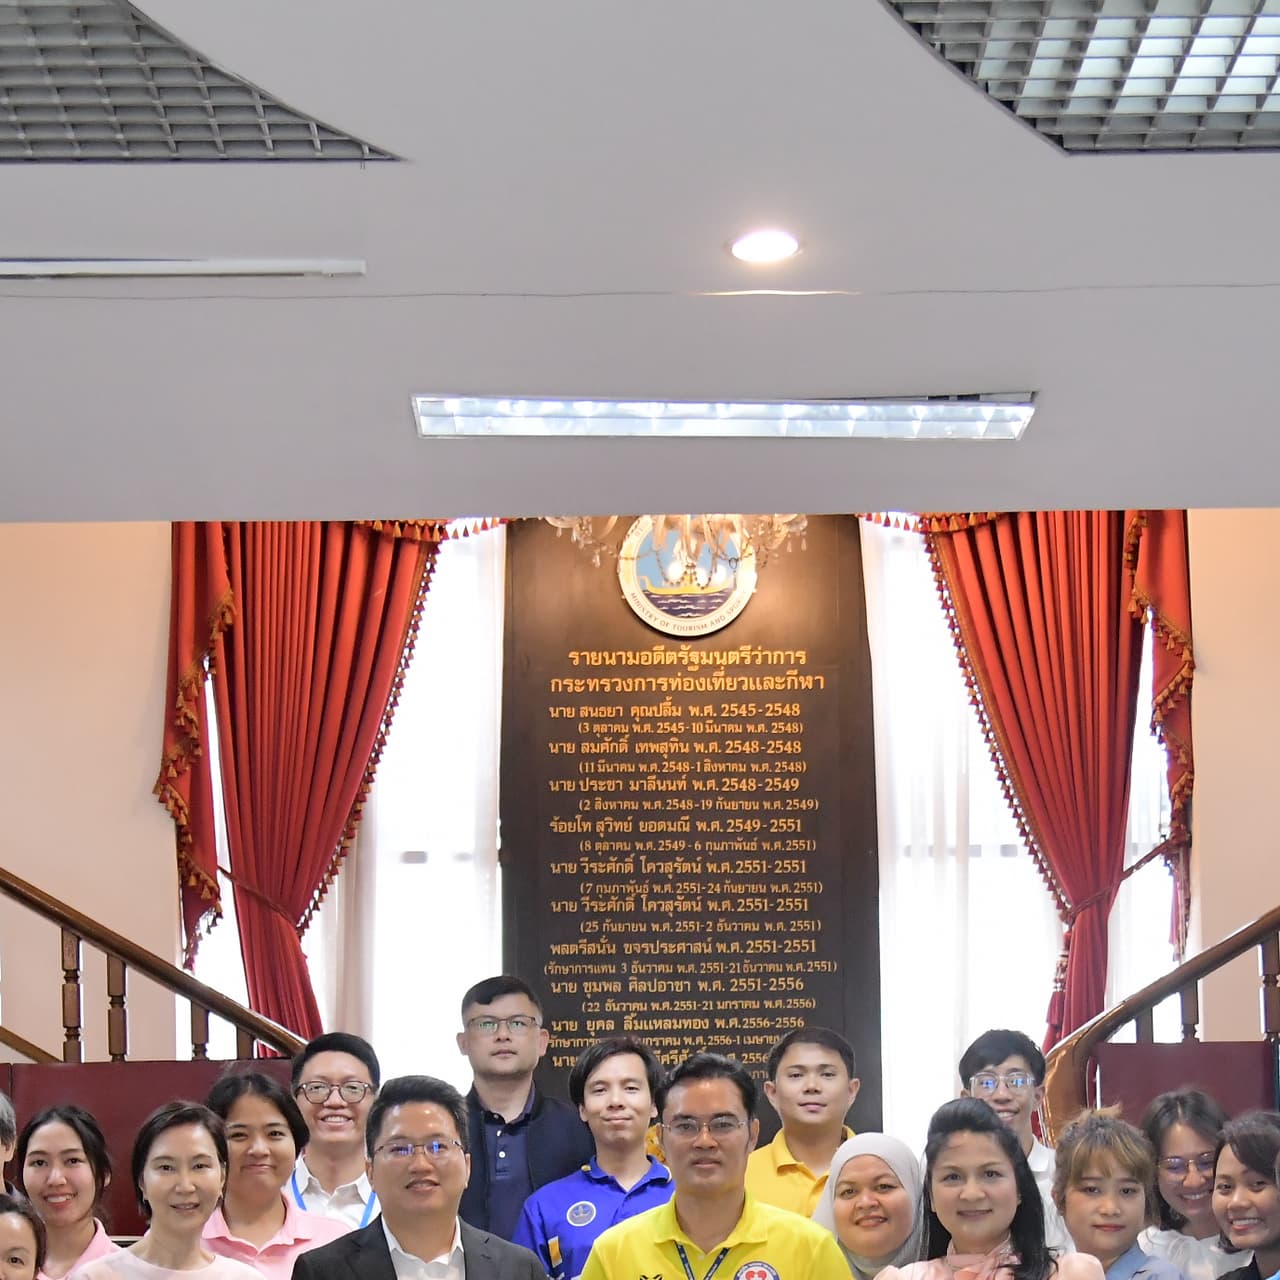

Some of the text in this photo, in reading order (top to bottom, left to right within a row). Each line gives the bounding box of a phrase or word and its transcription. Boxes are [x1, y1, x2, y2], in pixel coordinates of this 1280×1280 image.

[568, 644, 807, 671] รายนามอดีตรัฐมนตรีว่าการ
[550, 666, 824, 692] กระทรวงการท่องเที่ยวและกีฬา
[549, 706, 575, 717] นาย
[631, 696, 681, 722] คุณปลื้ม
[549, 742, 575, 754] นาย
[549, 780, 575, 792] นาย
[549, 815, 592, 833] ร้อยโท
[639, 816, 690, 833] ยอดมณี
[551, 863, 577, 874] นาย
[551, 901, 578, 912] นาย
[551, 982, 577, 993] นาย
[552, 1020, 578, 1031] นาย
